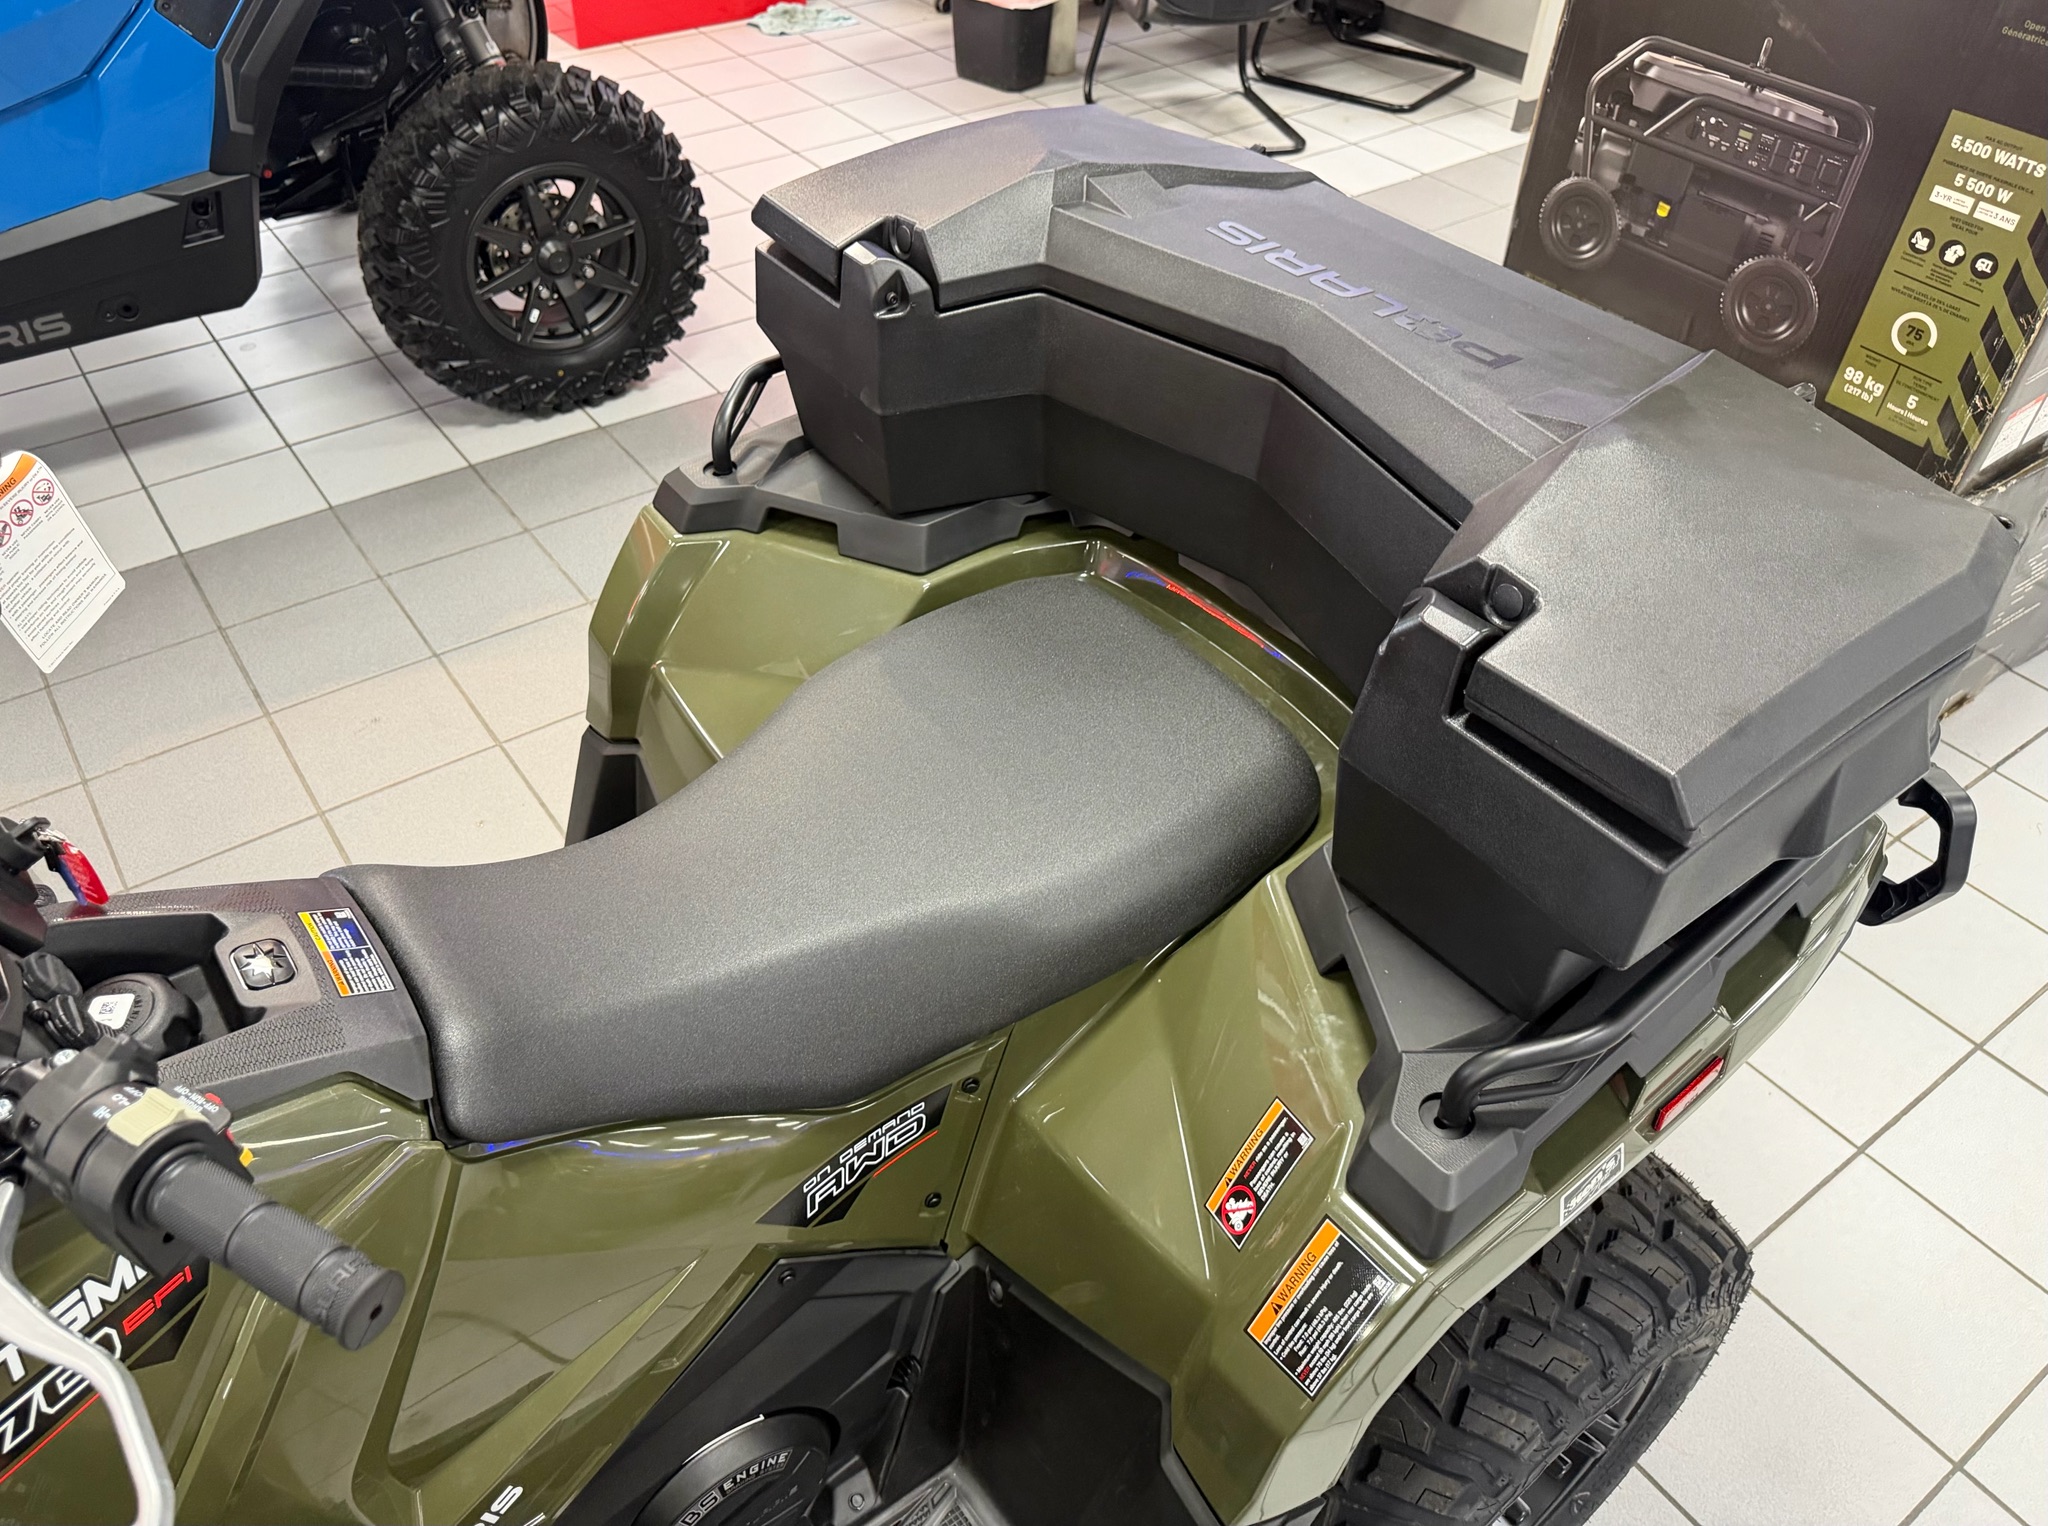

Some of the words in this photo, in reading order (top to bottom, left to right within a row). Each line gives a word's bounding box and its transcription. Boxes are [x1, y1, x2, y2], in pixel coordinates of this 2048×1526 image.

[2024, 20, 2046, 33] Open
[1950, 134, 1993, 159] 5,500
[1994, 148, 2048, 178] WATTS
[1934, 191, 1953, 203] 3-YR
[1954, 173, 1966, 187] 5
[1965, 177, 1996, 198] 500
[1996, 187, 2014, 204] W
[1999, 215, 2016, 226] ANS
[1906, 324, 1925, 341] 75
[1843, 366, 1864, 385] 98
[1863, 375, 1885, 397] kg
[1843, 383, 1862, 397] (217
[1860, 391, 1875, 404] lb)
[1886, 402, 1905, 415] Hours
[1906, 411, 1929, 427] Heures
[1906, 394, 1919, 410] 5
[306, 922, 321, 941] CAUTION
[326, 959, 342, 982] WARNING
[803, 1165, 831, 1193] ON
[839, 1102, 925, 1164] DEMAND
[1229, 1128, 1264, 1176] WARNING
[806, 1113, 927, 1219] AWD
[1243, 1160, 1257, 1179] NEVER
[1255, 1151, 1263, 1162] ride
[1249, 1159, 1270, 1188] Passengers
[1257, 1175, 1272, 1197] SEVERE
[1270, 1156, 1285, 1177] INJURY
[1276, 1251, 1317, 1302] WARNING
[121, 1265, 193, 1336] EFI
[1299, 1366, 1310, 1381] NEVER
[722, 1452, 789, 1491] ENGINE
